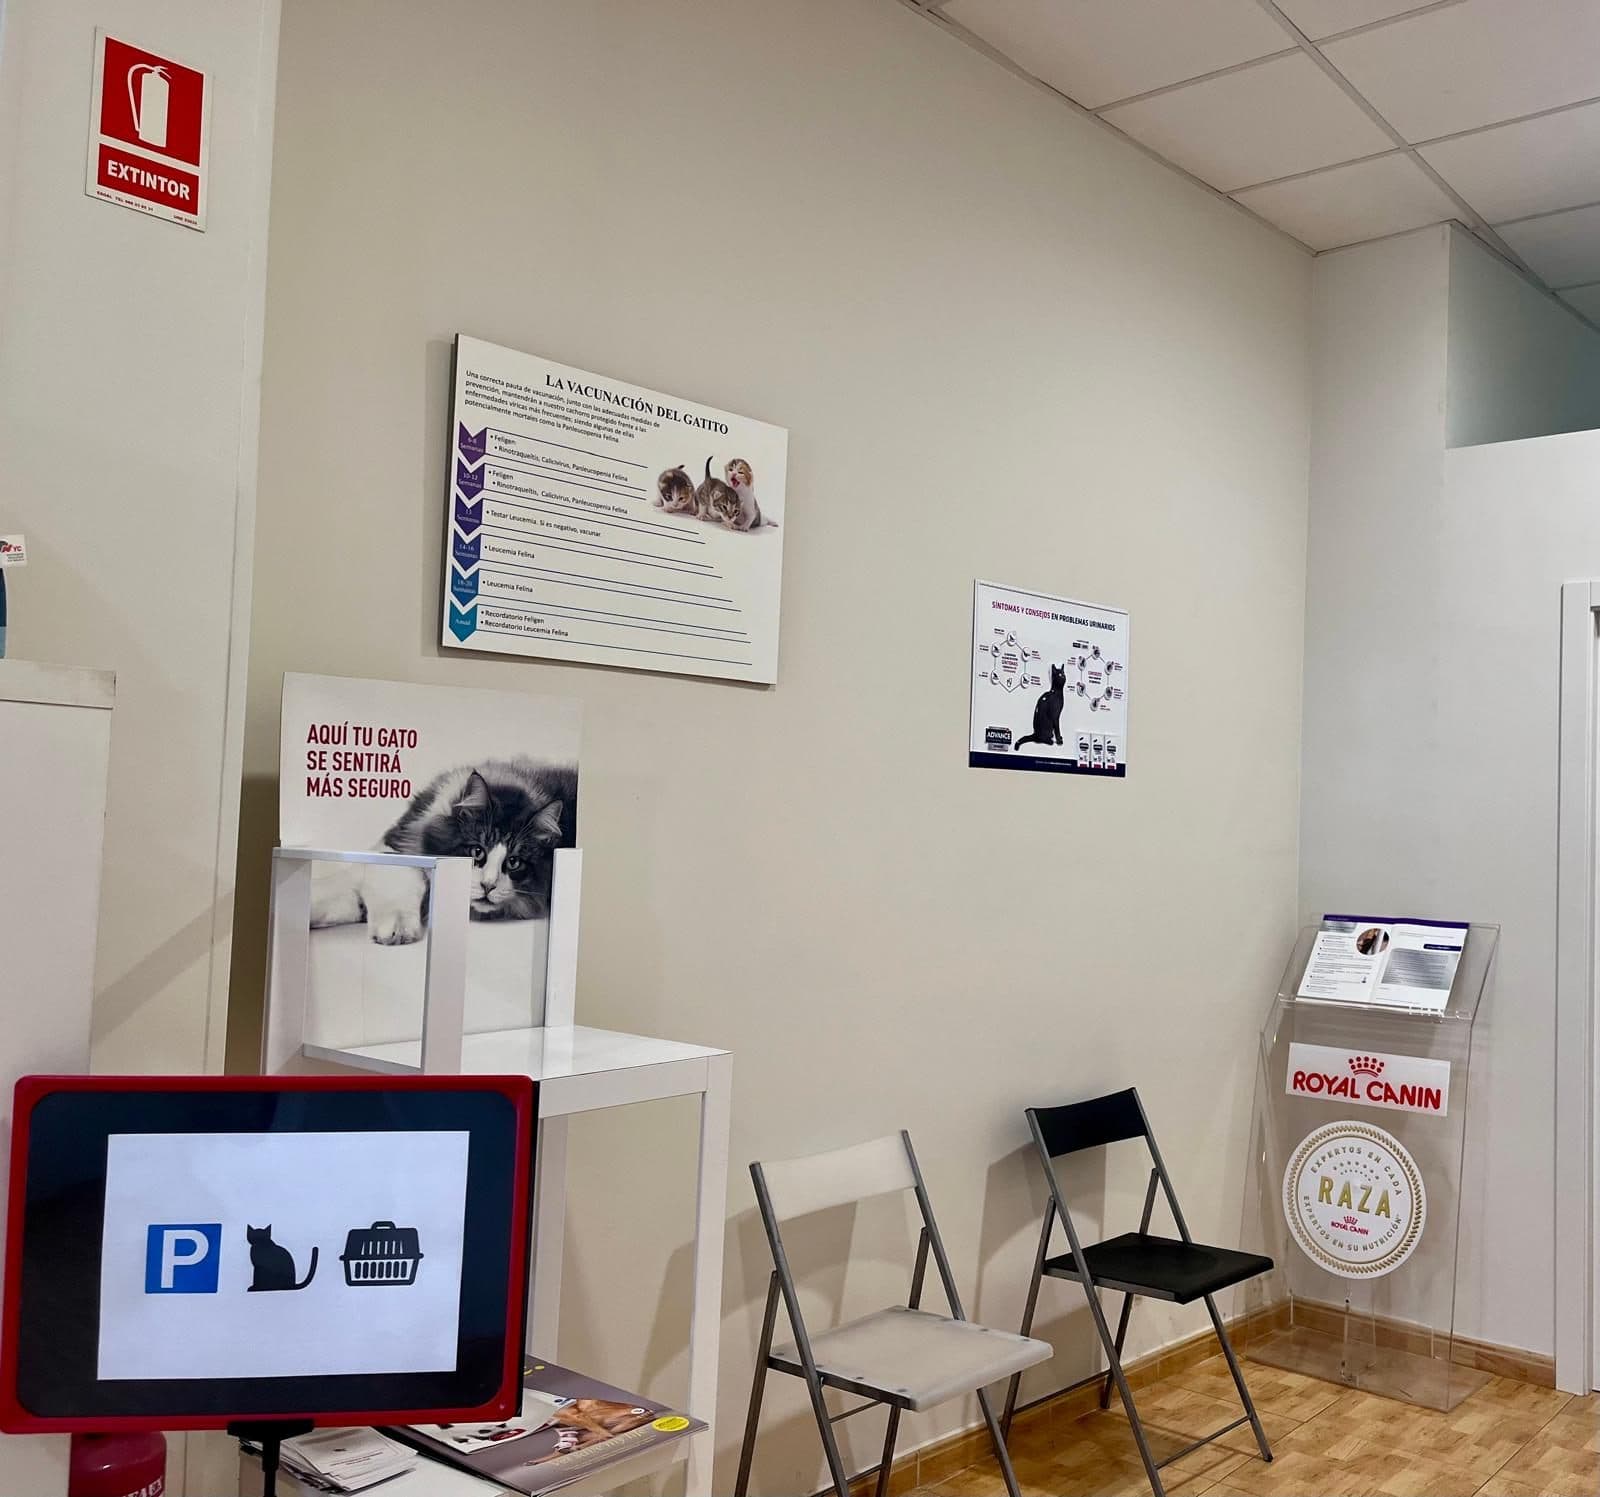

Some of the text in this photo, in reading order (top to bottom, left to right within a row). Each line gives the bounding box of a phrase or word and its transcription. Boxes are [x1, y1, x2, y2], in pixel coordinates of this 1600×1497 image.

[108, 159, 190, 200] EXTINTOR
[466, 370, 478, 379] Una
[480, 374, 504, 386] correcta
[506, 382, 522, 391] pauta
[566, 398, 581, 407] junto
[593, 404, 601, 413] las
[602, 408, 630, 420] adecuadas
[631, 415, 652, 426] medidas
[502, 390, 537, 404] mantendrán
[544, 401, 565, 411] nuestro
[566, 406, 590, 418] cachorro
[591, 413, 617, 426] protegido
[618, 420, 633, 430] frente
[546, 374, 728, 434] LA VACUNACIÓN DEL GATITO
[465, 390, 508, 405] enfermedades
[574, 418, 592, 427] siendo
[593, 423, 613, 434] algunas
[622, 430, 635, 439] ellas
[465, 399, 511, 415] potencialmente
[512, 411, 538, 422] mortales
[539, 418, 555, 426] como
[556, 421, 561, 429] la
[603, 434, 619, 443] Felina
[494, 435, 515, 445] Feligen
[492, 470, 514, 480] Feligen
[572, 463, 611, 478] Panleucopenia
[612, 473, 628, 482] Felina
[572, 497, 611, 511] Panleucopenia
[612, 506, 628, 514] Felina
[491, 510, 508, 519] Testar
[553, 523, 579, 533] negativo,
[489, 545, 535, 559] Leucemia Felina
[487, 580, 533, 593] Leucemia Felina
[484, 620, 568, 637] Recordatorio Leucemia Felina
[485, 610, 544, 624] Recordatorio Feligen
[992, 601, 1020, 613] SÍNTOMAS
[1025, 607, 1050, 619] CONSEJOS
[1060, 614, 1088, 626] PROBLEMAS
[1089, 621, 1116, 631] URINARIOS
[307, 721, 417, 748] AQUÍ TU GATO
[987, 731, 1011, 740] ADVANCE
[307, 750, 401, 773] SE SENTIRÁ
[307, 772, 411, 798] MÁS SEGURO
[1293, 1070, 1441, 1110] ROYAL CANIN
[1310, 1146, 1403, 1196] EXPERTOS EN CADA
[1318, 1176, 1391, 1219] RAZA
[1303, 1195, 1330, 1240] EXPERTOS
[1332, 1240, 1344, 1249] EN
[1362, 1218, 1402, 1251] NUTRICIÓN
[1331, 1221, 1369, 1235] ROYAL CANIN
[160, 1229, 209, 1288] P
